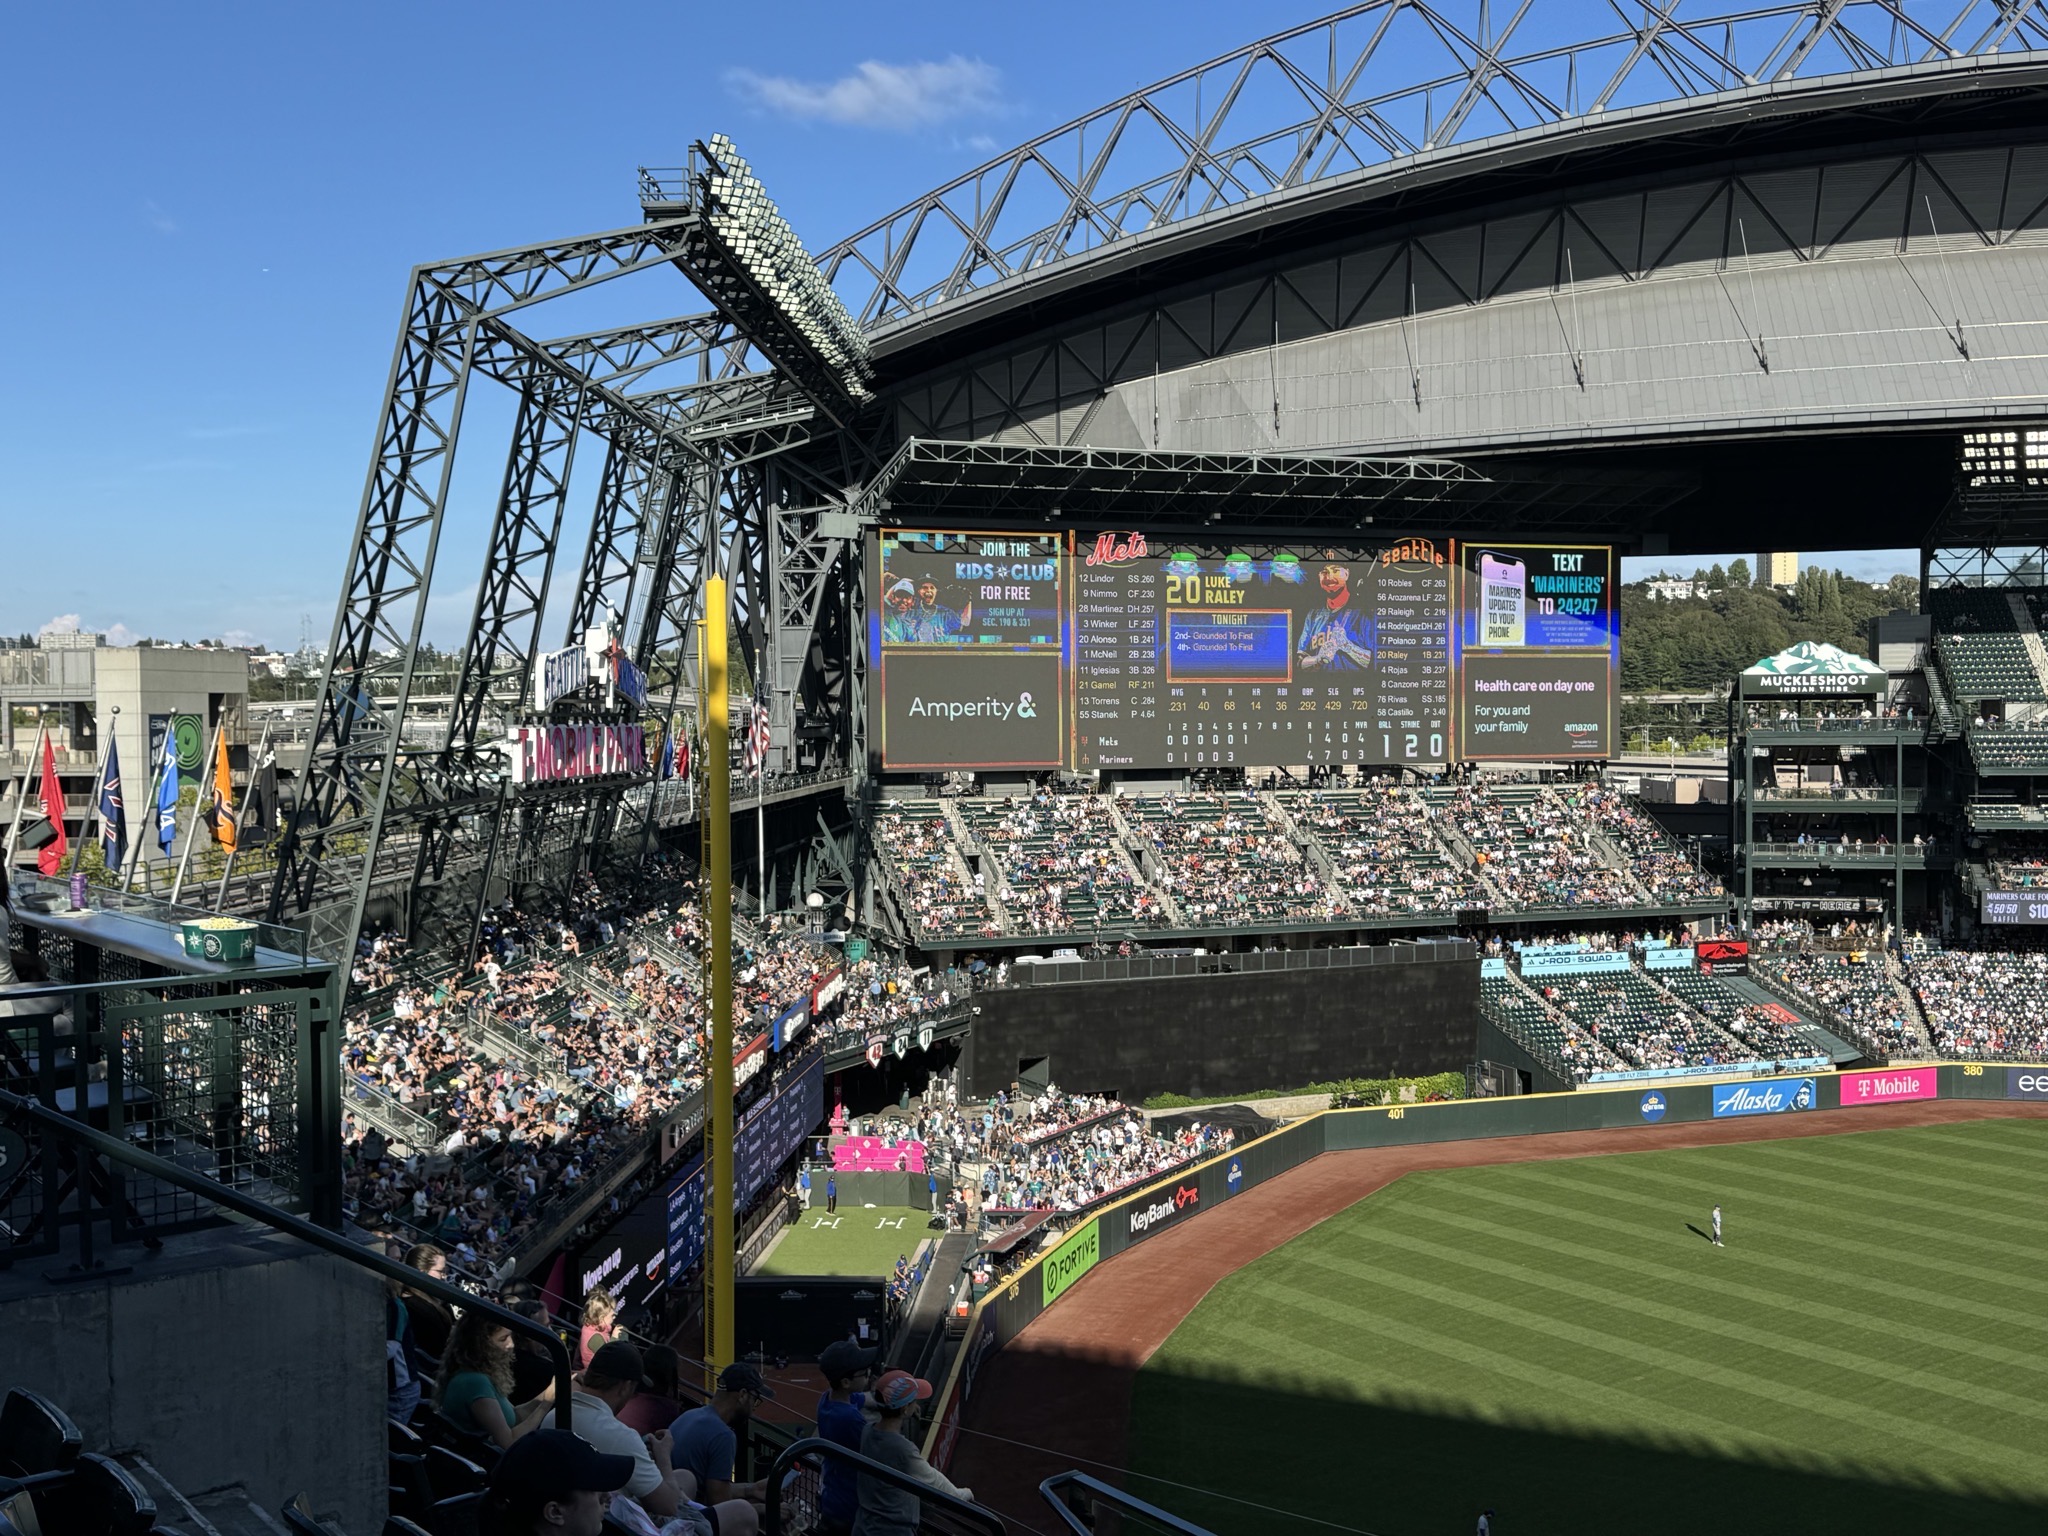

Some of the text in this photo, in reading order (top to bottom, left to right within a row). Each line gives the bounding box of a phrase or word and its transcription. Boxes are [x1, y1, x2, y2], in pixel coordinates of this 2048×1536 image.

[980, 542, 1030, 557] JOIN THE
[1086, 531, 1148, 567] Mets
[1382, 540, 1444, 569] seattle
[1552, 553, 1584, 572] TEXT
[955, 562, 1055, 581] KIDS CLUB
[1079, 574, 1088, 583] 12
[1090, 574, 1114, 583] Lindor
[1127, 574, 1139, 583] SS
[1205, 576, 1231, 588] LUKE
[1388, 579, 1412, 587] Robles
[981, 586, 1031, 600] FOR FREE
[1090, 590, 1118, 598] Nimmo
[1127, 590, 1139, 598] CF
[1166, 575, 1201, 604] 20
[1488, 584, 1522, 600] MARINERS
[1205, 590, 1246, 604] RALEY
[1388, 593, 1421, 601] Arozarena
[1078, 605, 1088, 613] 28
[1090, 605, 1123, 613] Martinez
[1127, 605, 1139, 613] DH
[1488, 599, 1517, 612] UPDATES
[1537, 597, 1598, 616] TO 24247
[989, 607, 1025, 617] SIGN UP AT
[1388, 608, 1415, 617] Raleigh
[982, 617, 1031, 627] SEC. 190 331
[1211, 614, 1249, 625] TONIGHT
[1489, 612, 1515, 625] TO YOUR
[1090, 620, 1118, 628] Winker
[1128, 620, 1139, 628] LF
[1388, 622, 1421, 631] Rodriguez
[1193, 632, 1227, 640] Grounded
[1488, 625, 1510, 638] PHONE
[1079, 635, 1089, 643] 20
[1090, 635, 1117, 643] Alonso
[1129, 635, 1139, 643] 1B
[1388, 637, 1416, 645] Polanco
[1193, 643, 1227, 651] Grounded
[1090, 650, 1117, 658] McNeil
[1128, 650, 1139, 658] 2B
[1388, 651, 1408, 661] Raley
[1080, 666, 1088, 674] 11
[1090, 666, 1120, 676] Iglesias
[1129, 666, 1139, 674] 3B
[1388, 666, 1408, 676] Rojas
[1079, 681, 1139, 689] 21 Gamel RF
[1388, 680, 1419, 688] Canzone
[1760, 675, 1868, 687] MUCKLESHOOT
[1475, 679, 1595, 694] Health care on day one
[1171, 688, 1184, 696] AVG
[1080, 697, 1120, 705] 13 Torrens
[1388, 695, 1407, 703] Rivas
[908, 696, 1015, 722] Amperity
[1198, 701, 1210, 711] 40
[1224, 701, 1236, 711] 68
[1250, 701, 1261, 711] 14
[1276, 701, 1288, 711] 36
[1475, 704, 1530, 718] For you and
[1080, 710, 1118, 719] 55 Stanek
[1388, 708, 1414, 716] Castillo
[1378, 720, 1441, 729] BALL STRIKE OUT
[1474, 721, 1529, 735] your family
[1564, 722, 1598, 732] amazon
[1099, 736, 1118, 746] Mets
[1383, 733, 1443, 758] 1 2 0
[518, 726, 643, 783] T-MOBILE PARK
[1099, 754, 1133, 764] Mariners
[1986, 892, 2018, 901] MARINERS
[2019, 893, 2036, 901] CARE
[1539, 954, 1613, 966] J-ROD SQUAD
[923, 1030, 930, 1046] 11
[898, 1037, 908, 1053] 24
[872, 1044, 881, 1061] 42
[1712, 1065, 1739, 1073] SQUAD
[1963, 1065, 1983, 1076] 380
[1858, 1076, 1920, 1097] T Mobile
[1717, 1087, 1784, 1112] Alaska
[1642, 1103, 1665, 1113] Corona
[1387, 1108, 1405, 1120] 401
[1130, 1196, 1175, 1235] KeyBank
[602, 1256, 612, 1278] on
[612, 1247, 622, 1270] up
[1058, 1234, 1096, 1281] FORTIVE
